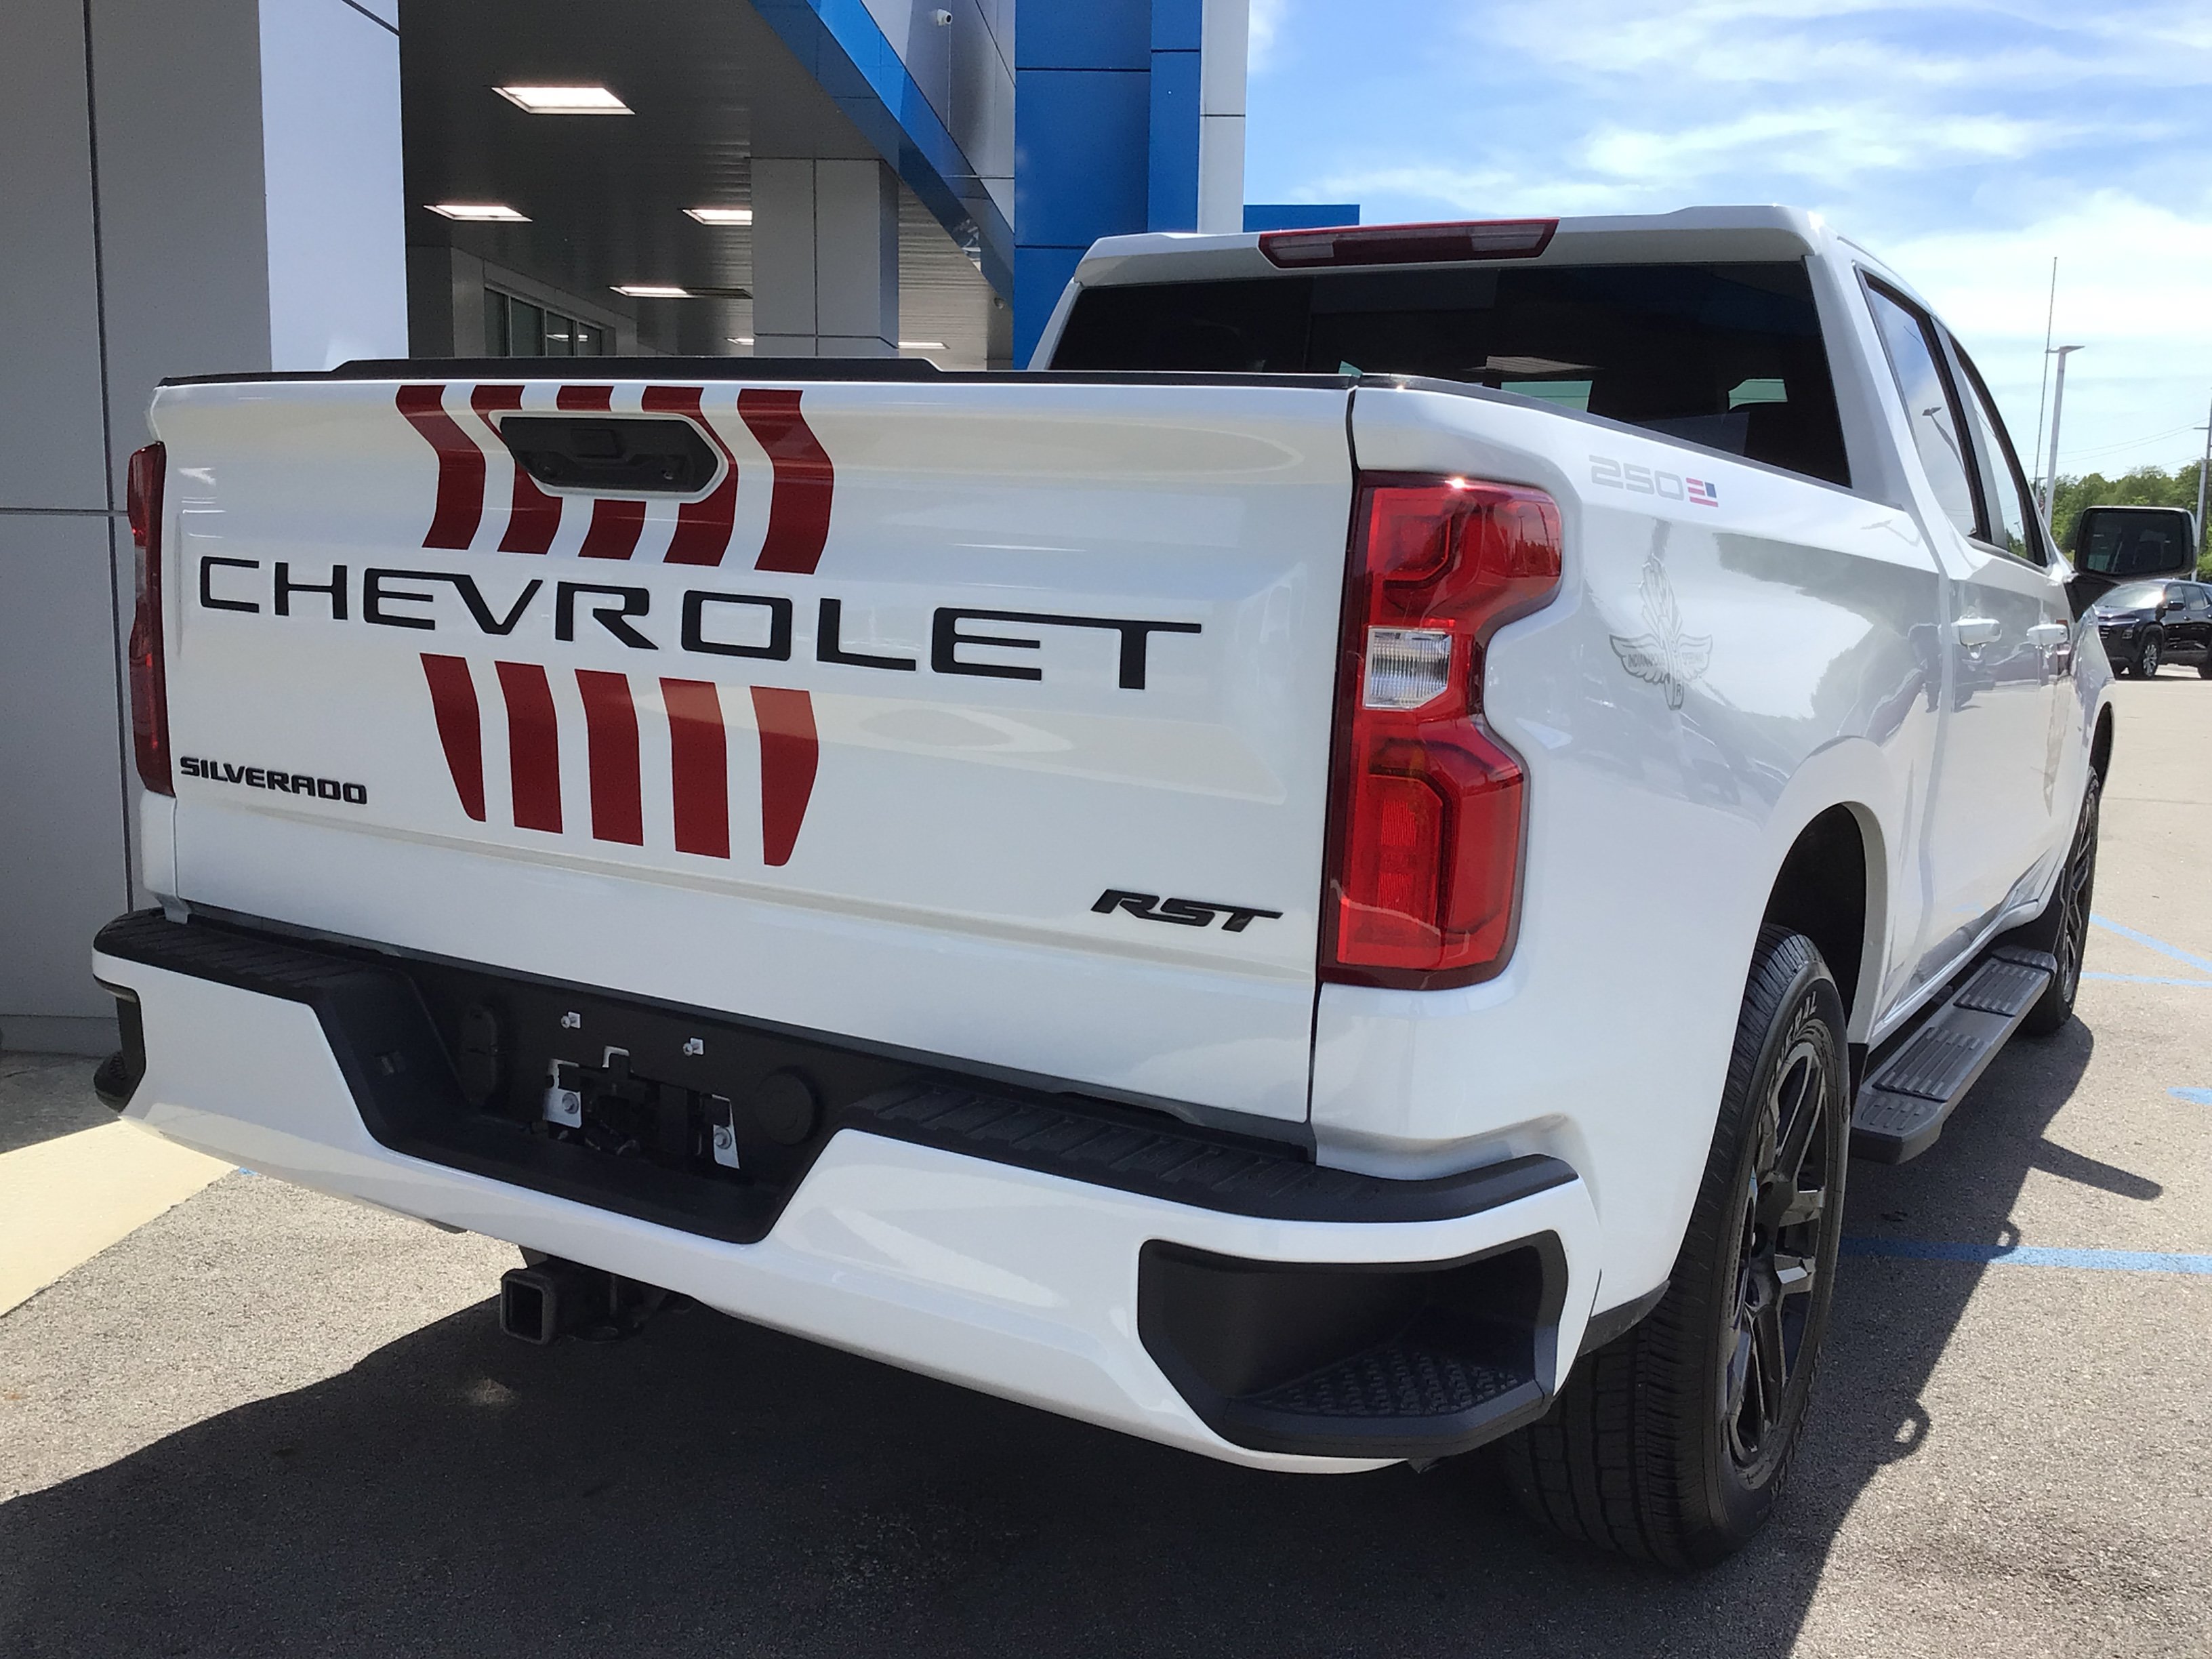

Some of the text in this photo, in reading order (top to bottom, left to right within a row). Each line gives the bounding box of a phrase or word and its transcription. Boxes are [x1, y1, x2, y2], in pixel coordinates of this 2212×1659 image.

[200, 556, 1202, 690] CHEVROLET
[180, 756, 367, 804] SILVERADO
[1090, 888, 1283, 933] RST
